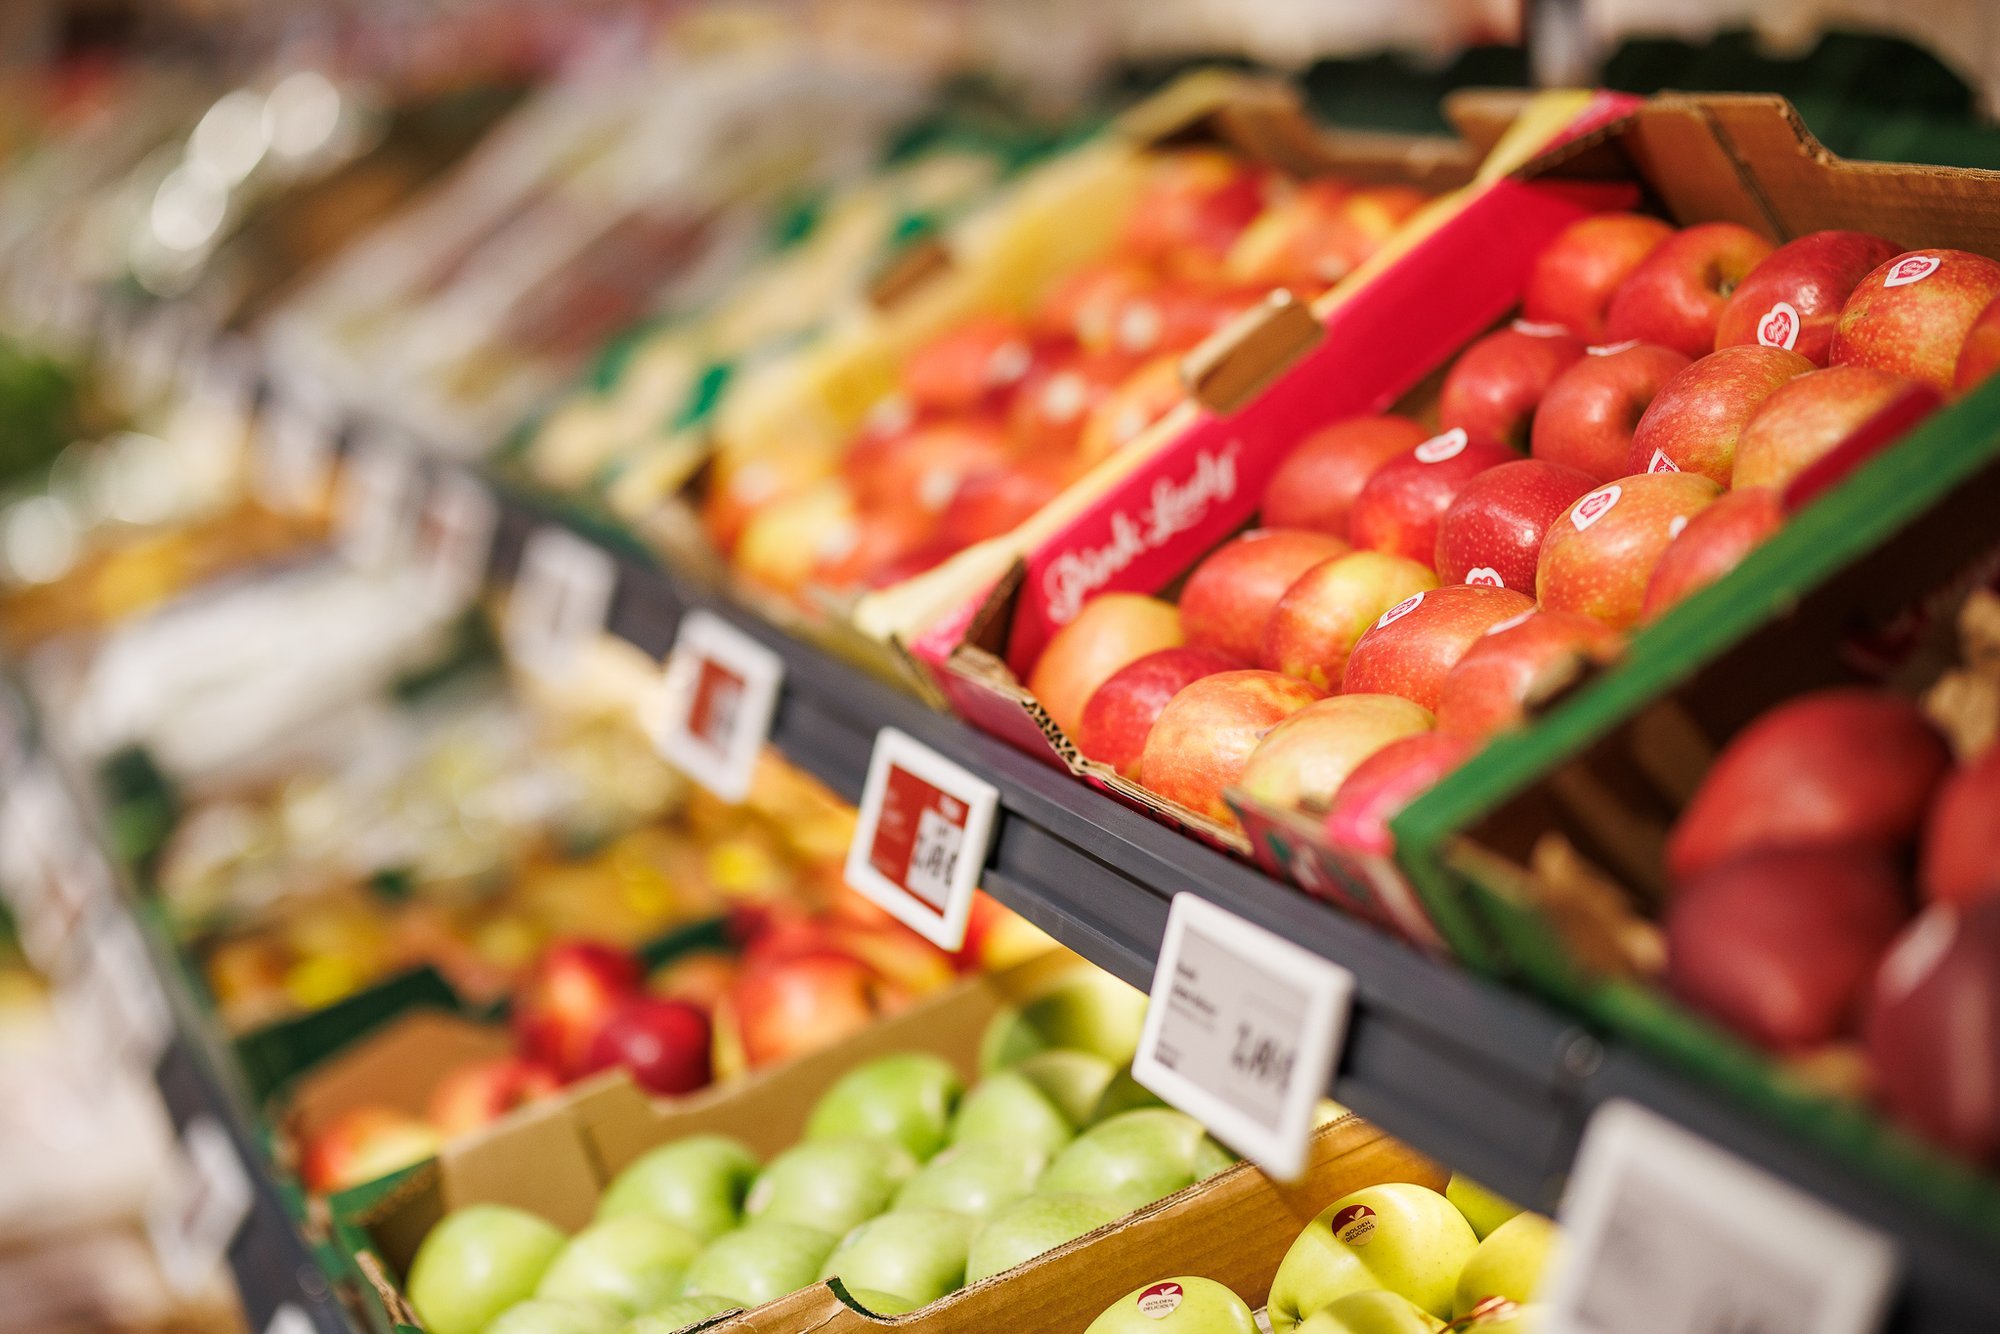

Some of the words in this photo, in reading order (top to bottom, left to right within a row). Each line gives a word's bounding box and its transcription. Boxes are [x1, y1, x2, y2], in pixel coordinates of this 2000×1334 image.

[1345, 1220, 1371, 1237] GOLDEN
[1345, 1224, 1375, 1242] DELICIOUS
[1143, 1303, 1174, 1311] DELICIOUS
